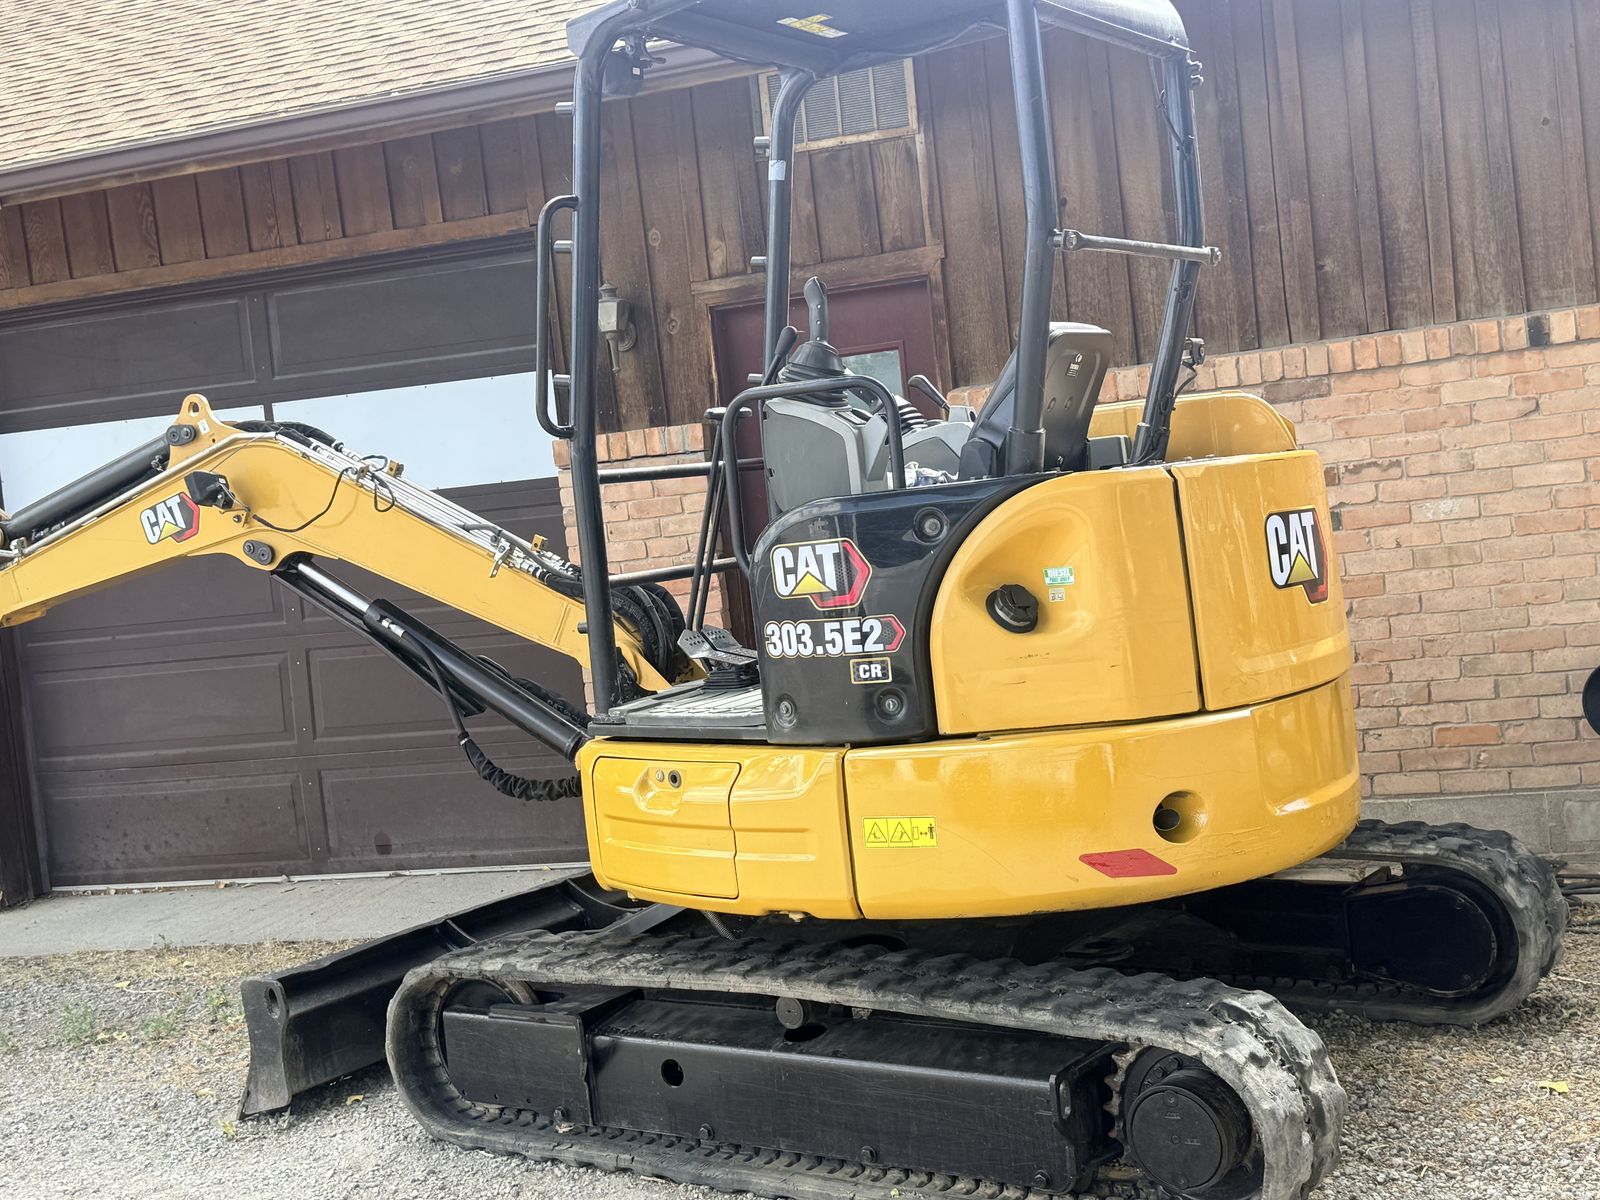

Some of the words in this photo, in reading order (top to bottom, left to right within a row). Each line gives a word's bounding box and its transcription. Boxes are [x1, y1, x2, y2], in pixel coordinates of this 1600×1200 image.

[141, 495, 186, 544] CAT
[773, 543, 840, 596] CAT
[1266, 512, 1319, 586] CAT
[766, 619, 884, 656] 303.5E2
[859, 664, 883, 679] CR
